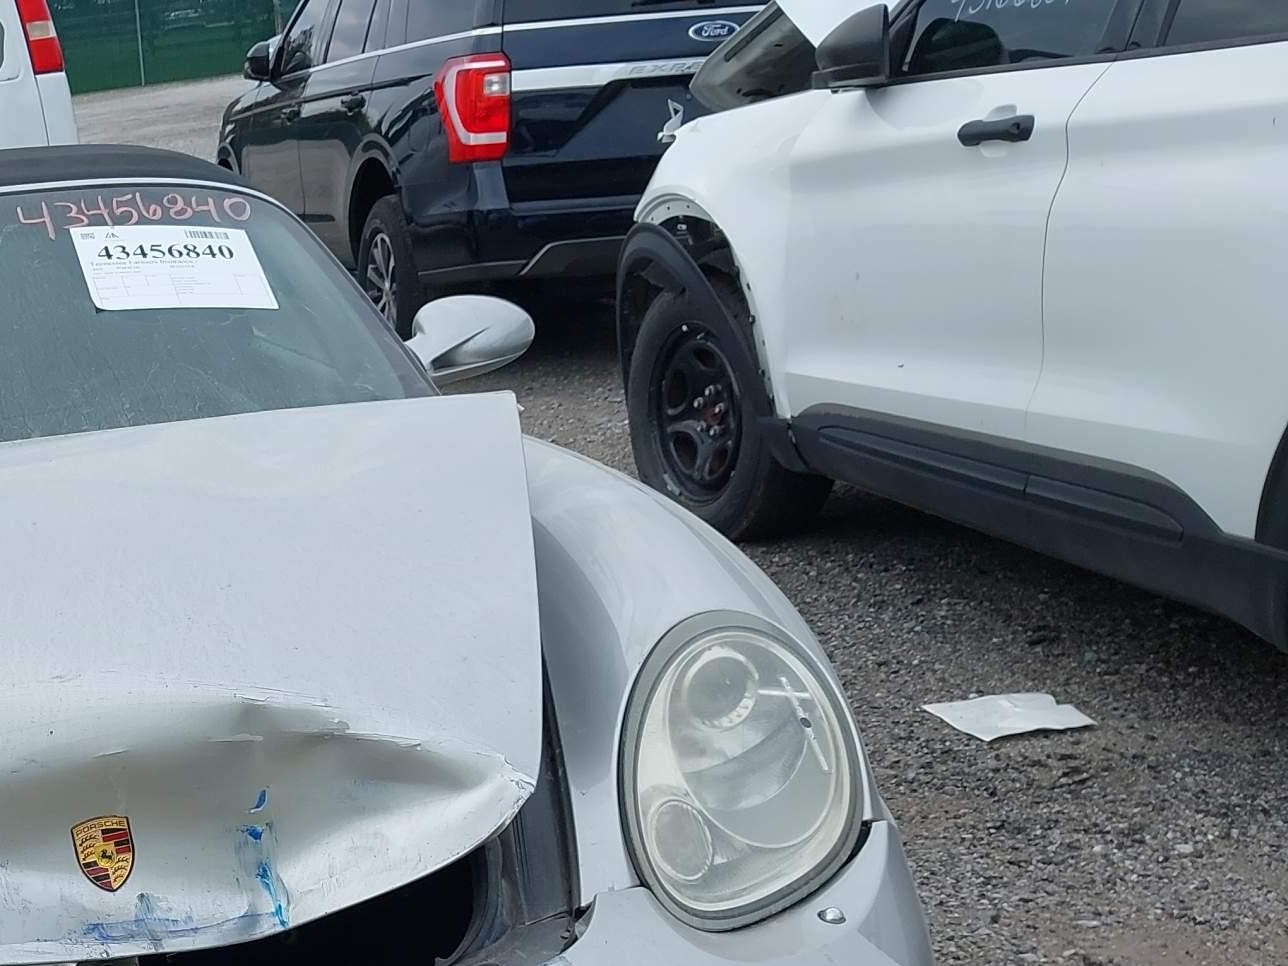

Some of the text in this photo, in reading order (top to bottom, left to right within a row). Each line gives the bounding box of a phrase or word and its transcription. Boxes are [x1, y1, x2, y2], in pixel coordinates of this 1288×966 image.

[701, 23, 729, 36] Ford
[16, 192, 251, 241] 43456840
[97, 243, 234, 260] 43456840
[75, 820, 126, 837] PORSCHE
